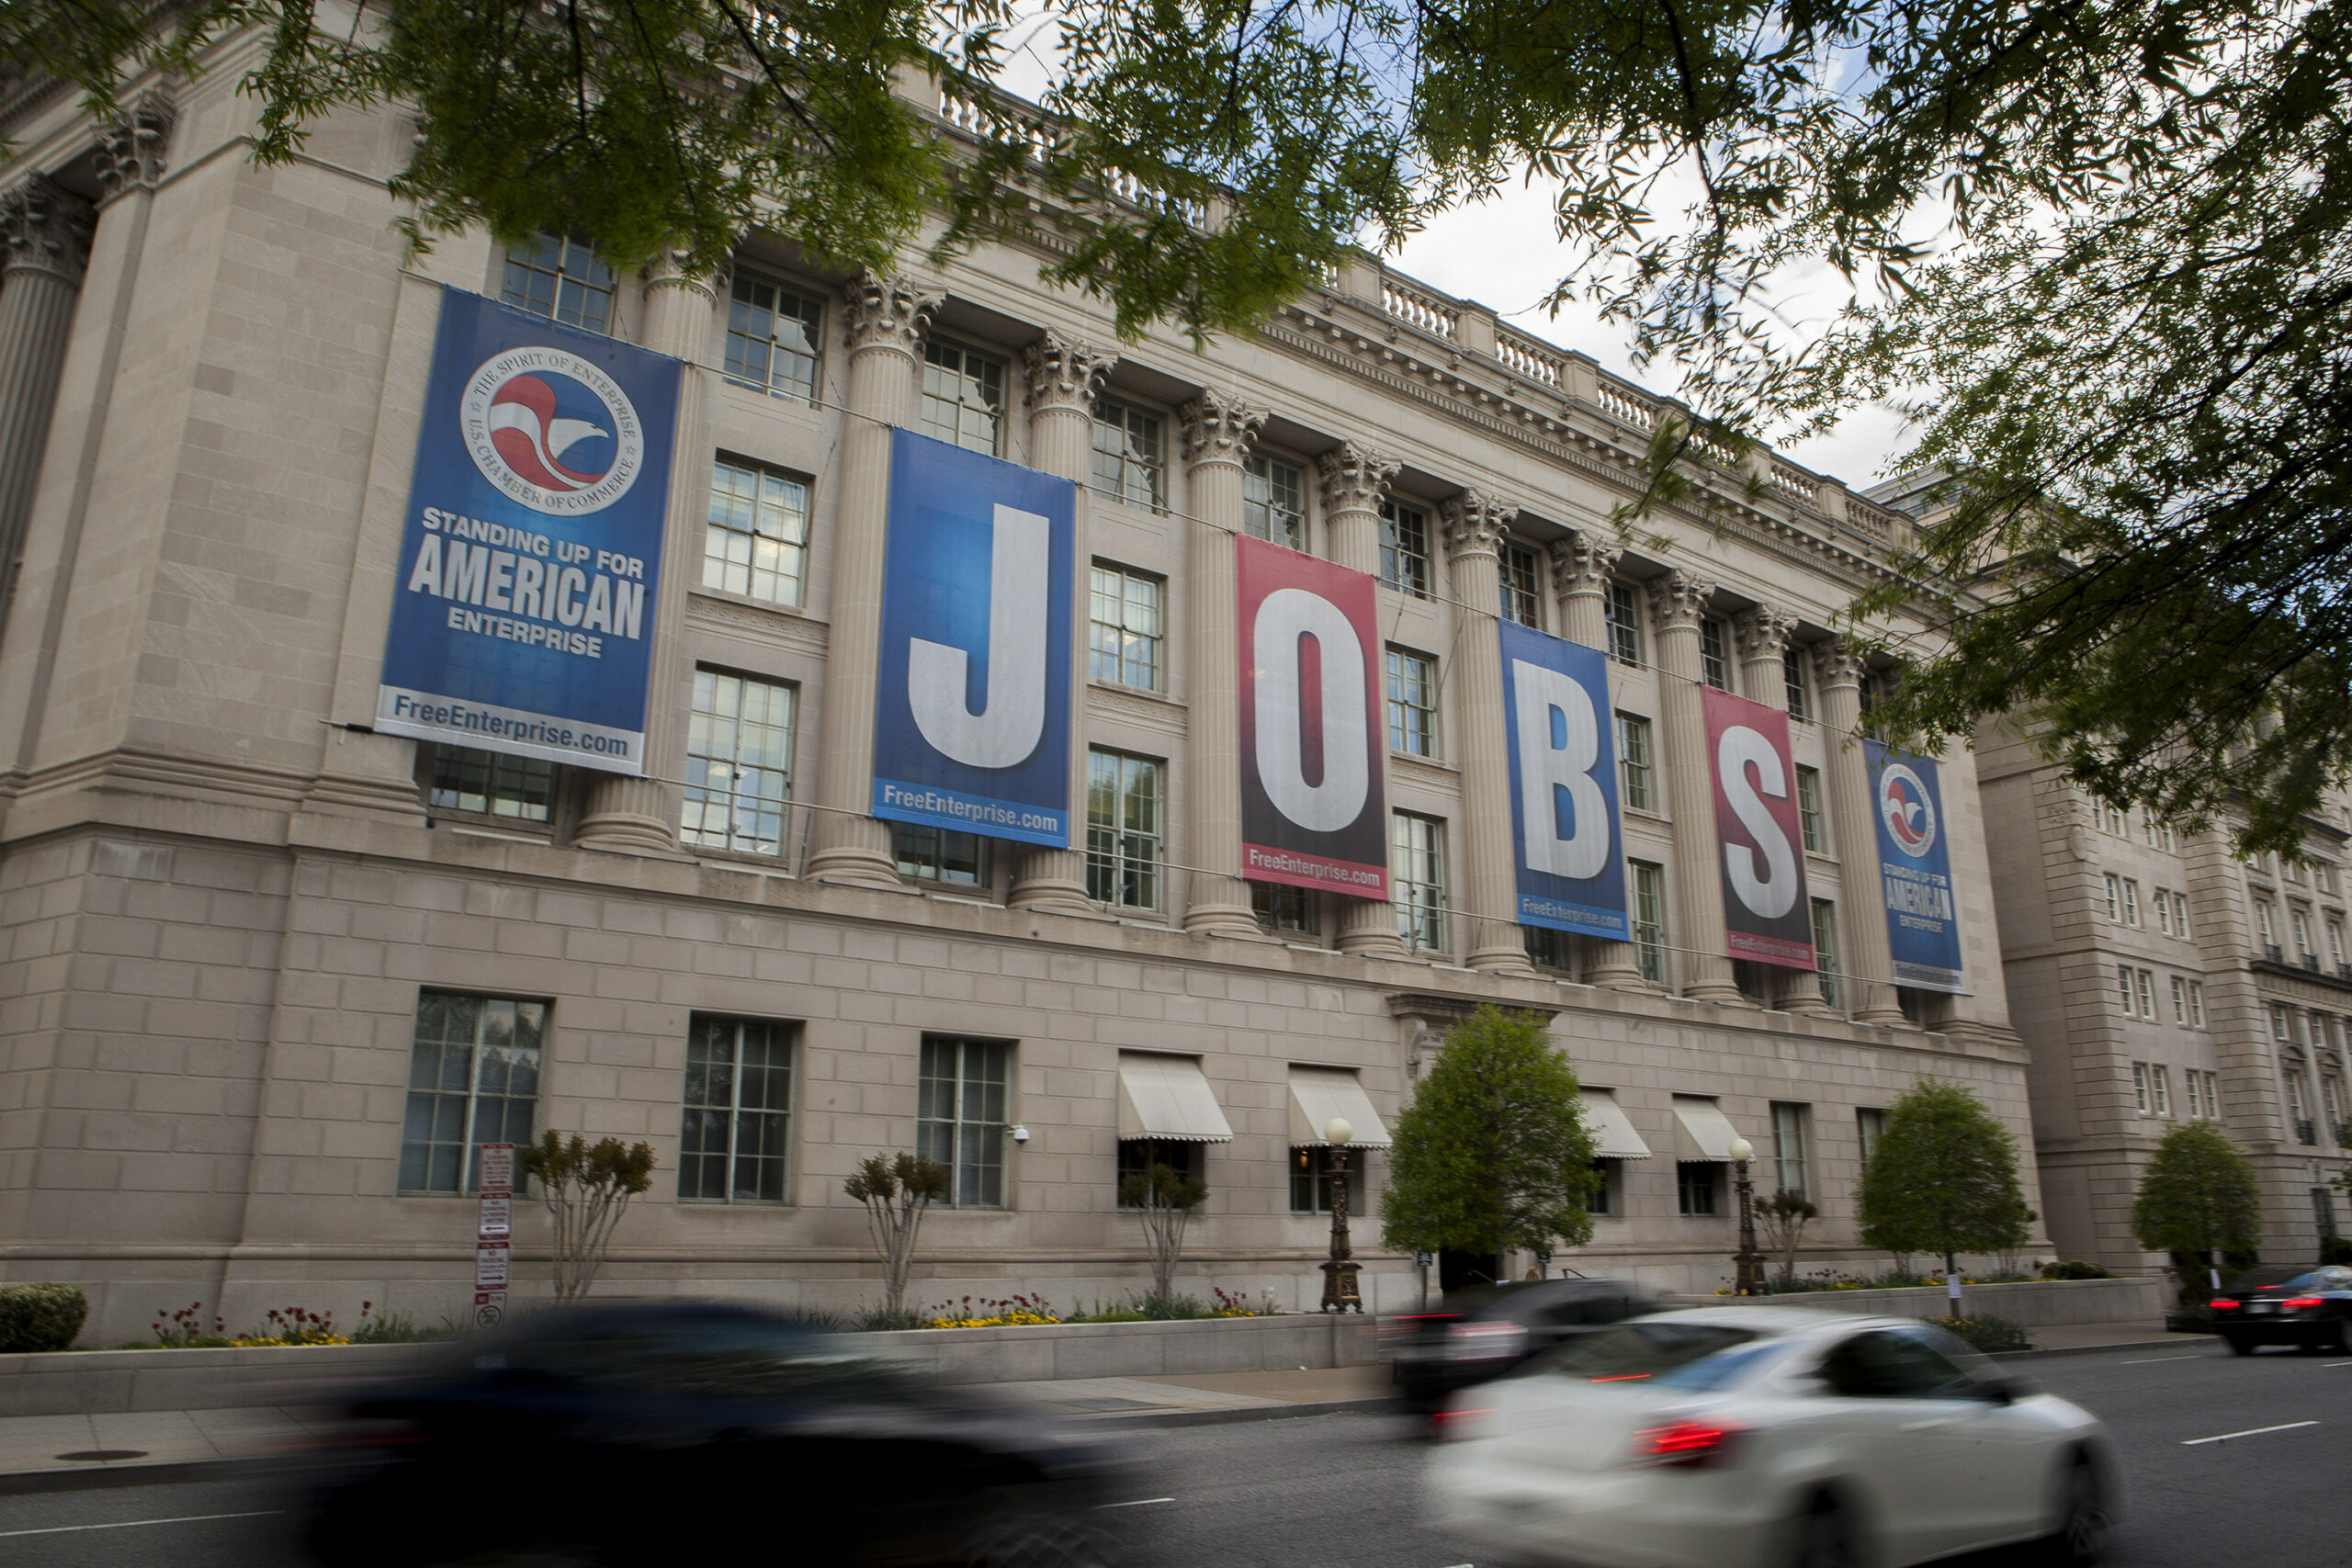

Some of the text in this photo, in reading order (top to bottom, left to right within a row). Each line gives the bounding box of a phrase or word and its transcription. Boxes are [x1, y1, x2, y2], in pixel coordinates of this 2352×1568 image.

[473, 352, 637, 440] THE SPIRIT OF ENTERPRISE
[476, 445, 543, 504] CHAMBER
[544, 493, 567, 510] OF
[566, 457, 636, 510] COMMERCE
[422, 505, 645, 580] STANDING UP FOR
[408, 533, 646, 641] AMERICAN
[447, 608, 603, 660] ENTERPRISE
[393, 694, 629, 757] FreeEnterprise.com
[883, 784, 1058, 833] FreeEnterprise.com
[1249, 848, 1381, 887] FreeEnterprise.com
[1883, 862, 1919, 881] STANDING
[1932, 874, 1948, 887] FOR
[1521, 897, 1623, 930] FreeEnterprise.com
[1885, 876, 1953, 921] AMERICAN
[1900, 915, 1943, 933] ENTERPRISE
